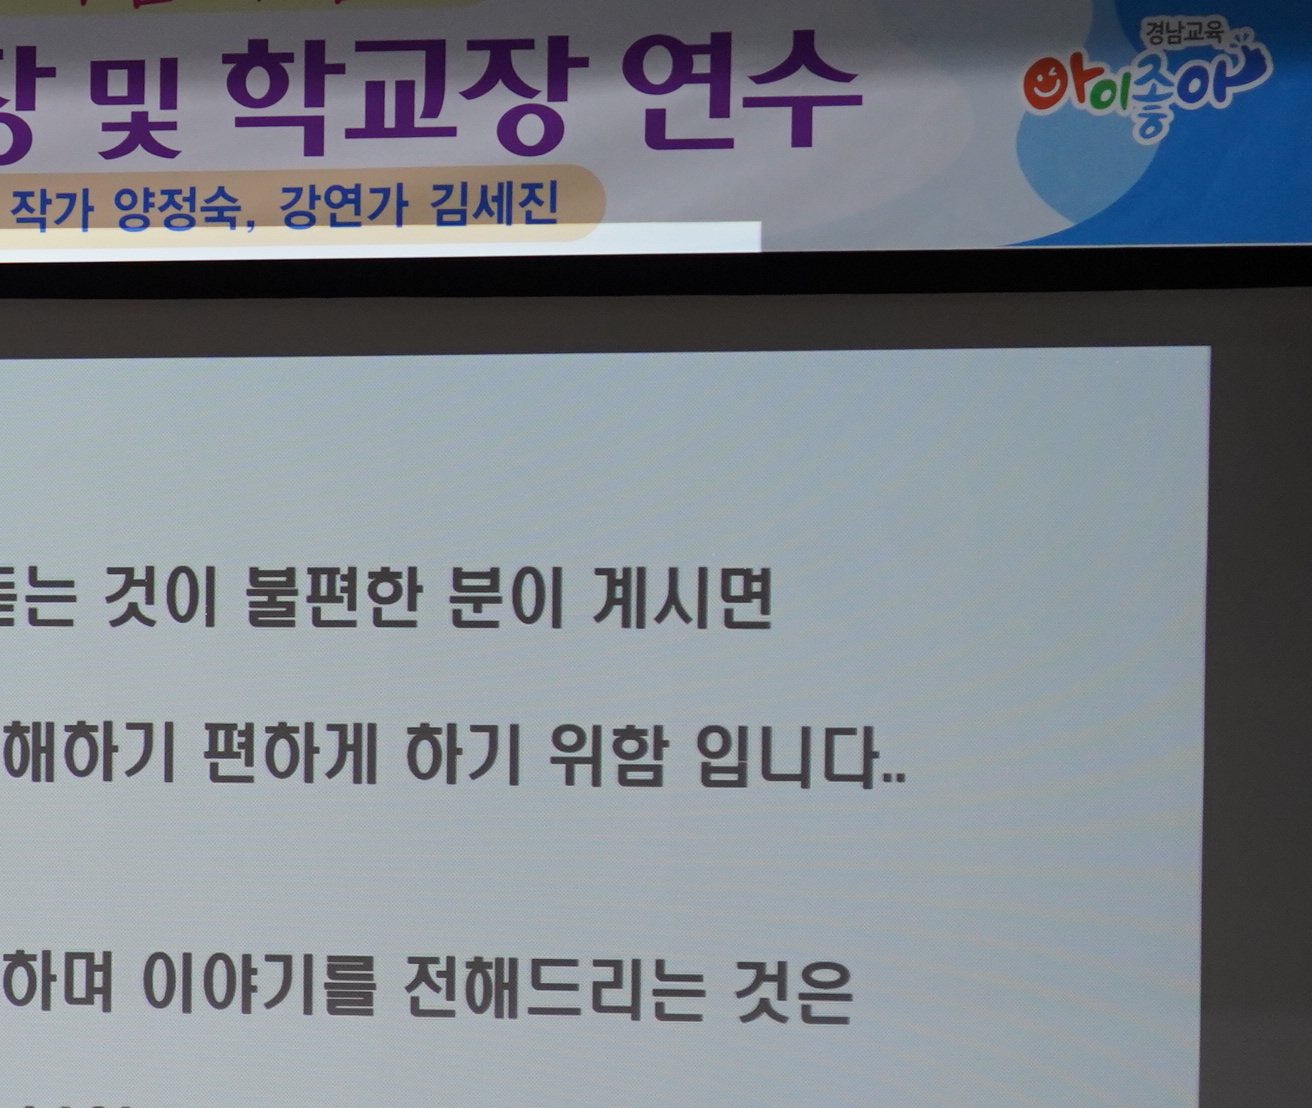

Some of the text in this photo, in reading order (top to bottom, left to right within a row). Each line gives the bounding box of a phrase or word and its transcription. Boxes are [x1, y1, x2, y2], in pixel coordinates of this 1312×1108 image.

[1145, 19, 1226, 46] 경남교육
[90, 57, 181, 160] 및
[221, 34, 590, 157] 학교장
[622, 28, 863, 151] 연수
[1022, 43, 1269, 140] 아이좋아
[11, 188, 94, 231] 작가
[114, 185, 255, 232] 양정숙,
[281, 182, 410, 229] 강연가
[431, 179, 558, 226] 김세진
[105, 565, 216, 628] 것이
[245, 565, 424, 629] 불편한
[448, 565, 563, 630] 분이
[593, 566, 771, 630] 계시면
[203, 721, 377, 785] 편하게
[406, 722, 520, 787] 하기
[549, 723, 670, 788] 위함
[696, 724, 906, 790] 입니다..
[2, 949, 112, 1013] 하며
[142, 951, 377, 1017] 이야기를
[404, 955, 707, 1022] 전해드리는
[735, 960, 853, 1025] 것은
